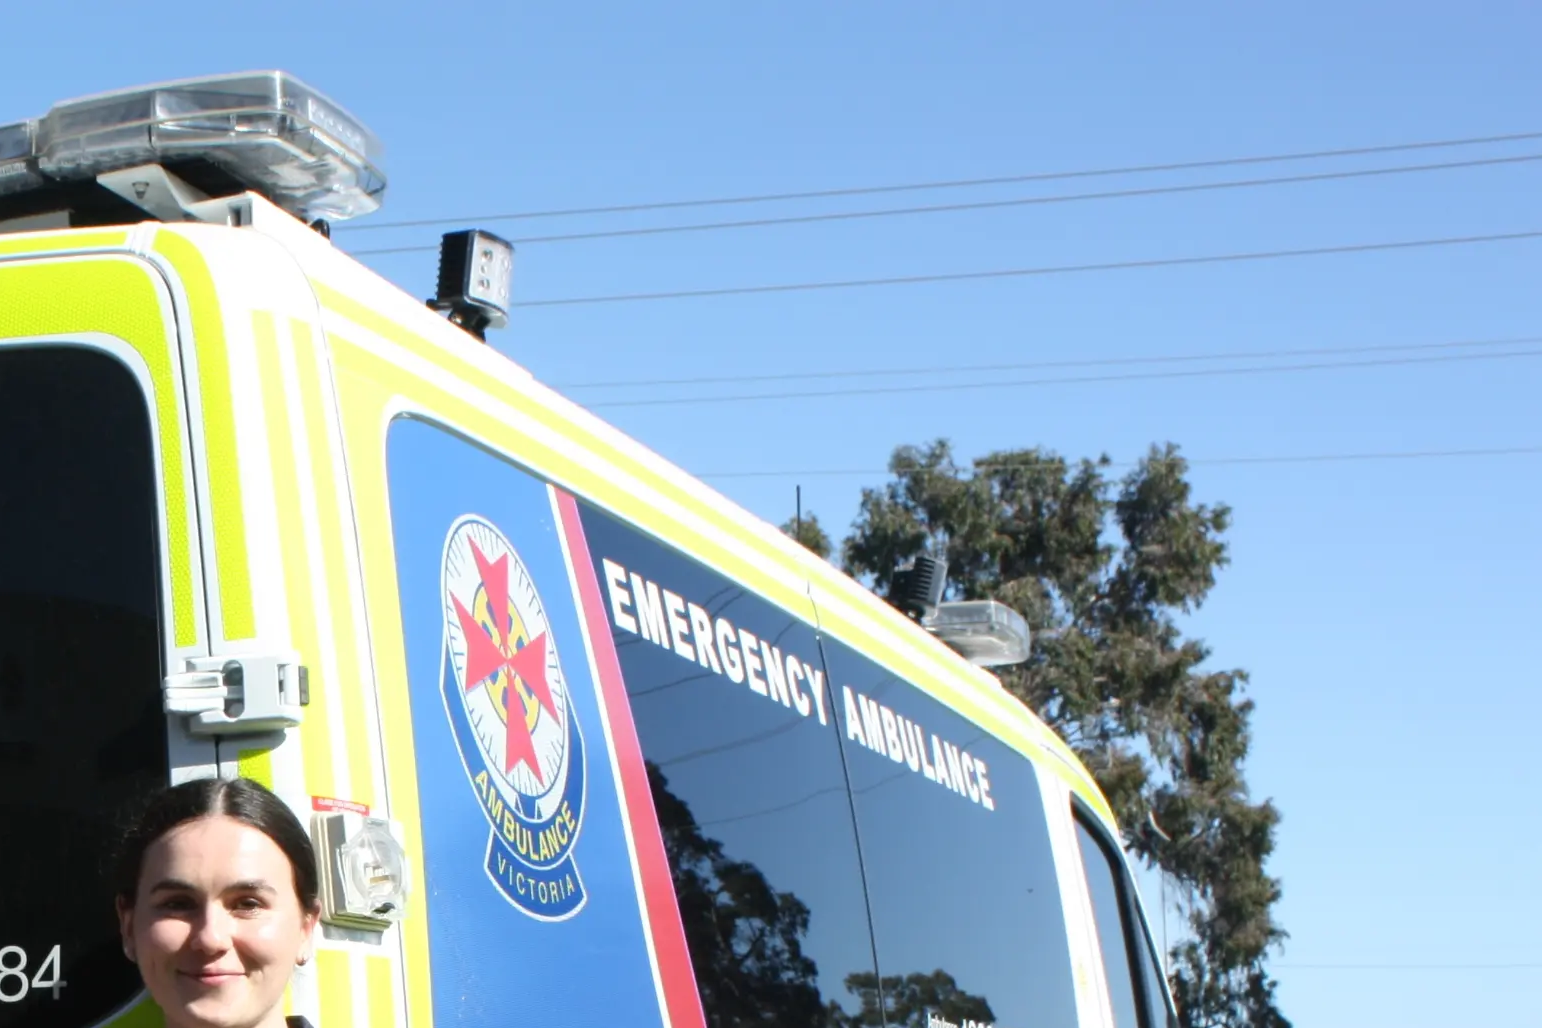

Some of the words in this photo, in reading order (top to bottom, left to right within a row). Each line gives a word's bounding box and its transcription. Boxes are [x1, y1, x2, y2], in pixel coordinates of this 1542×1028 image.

[602, 558, 827, 726] EMERGENCY
[842, 685, 995, 811] AMBULANCE
[475, 763, 576, 861] AMBULANCE
[496, 853, 575, 904] VICTORIA
